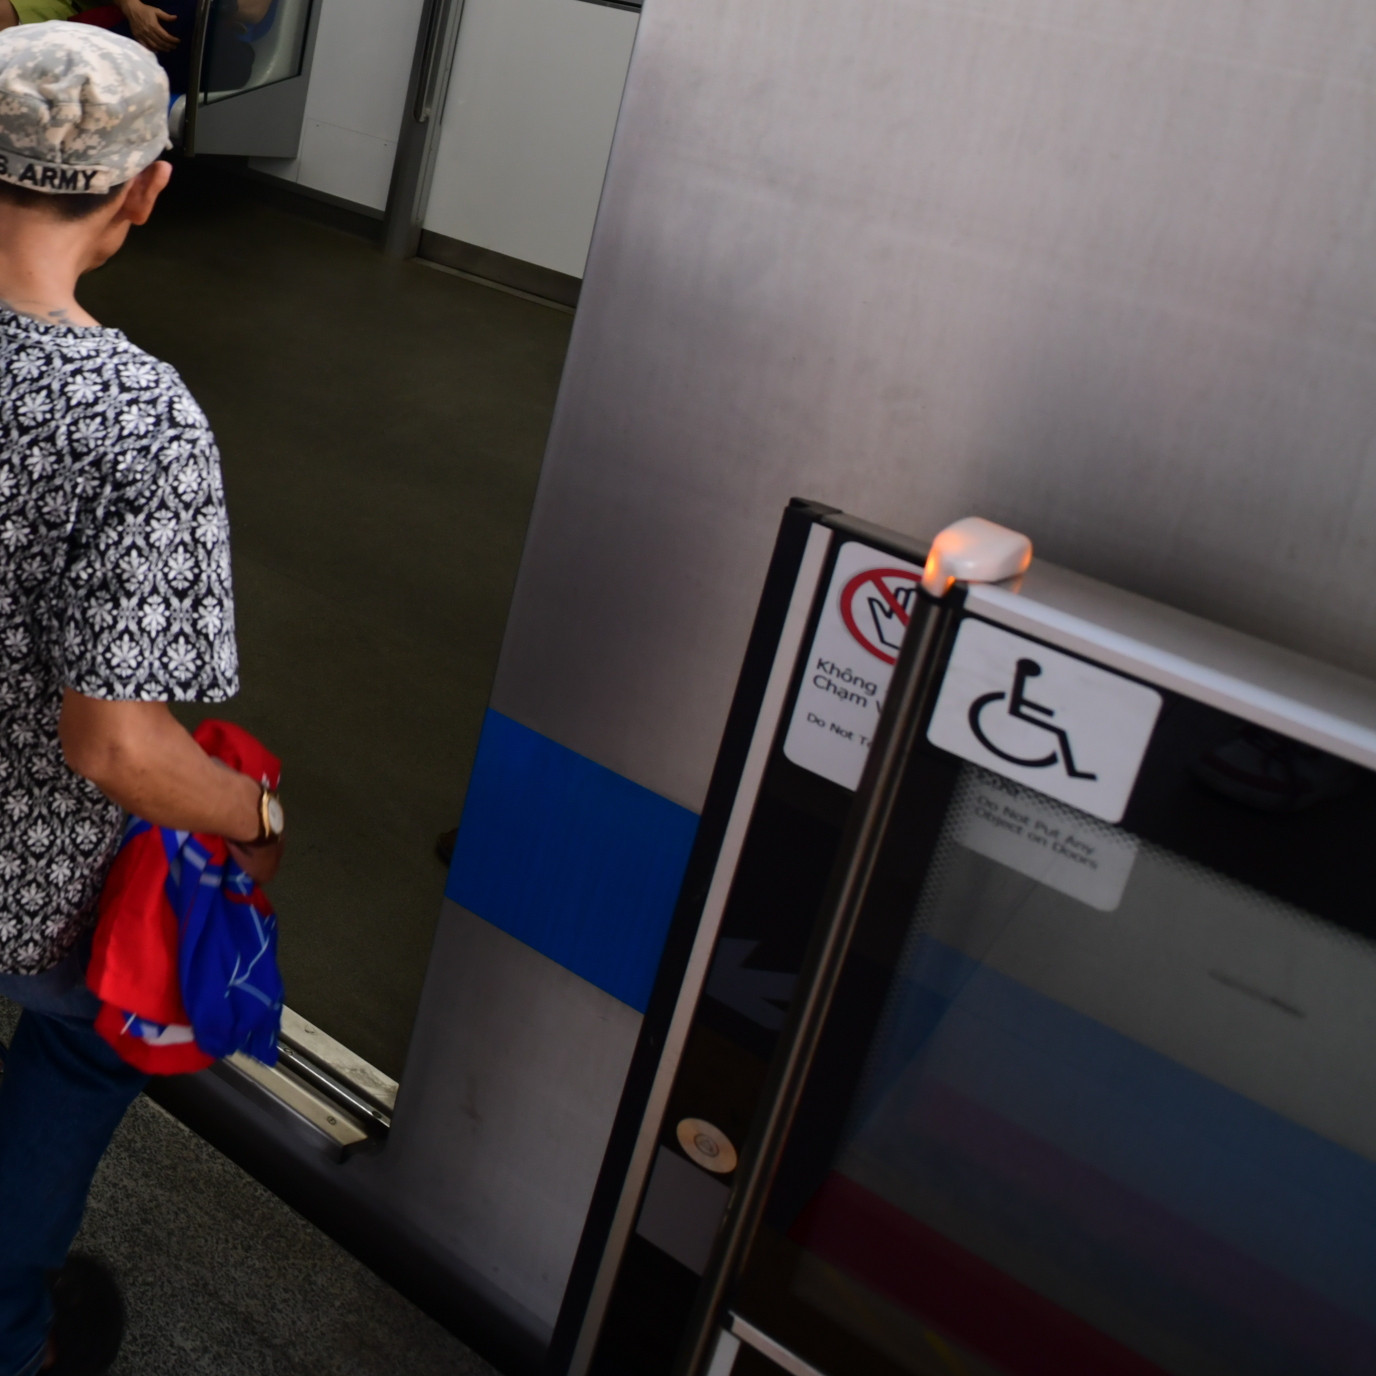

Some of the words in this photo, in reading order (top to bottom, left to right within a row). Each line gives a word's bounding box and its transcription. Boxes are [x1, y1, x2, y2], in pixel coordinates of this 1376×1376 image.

[18, 168, 98, 191] ARMY
[813, 675, 868, 708] Chạm
[816, 658, 878, 696] Không
[807, 712, 826, 728] Do
[829, 723, 853, 741] Not
[975, 808, 1023, 835] Object
[1027, 832, 1047, 847] on
[1051, 842, 1098, 870] Doors
[1003, 807, 1030, 824] Not
[1034, 821, 1059, 838] Put
[1065, 835, 1095, 855] Any
